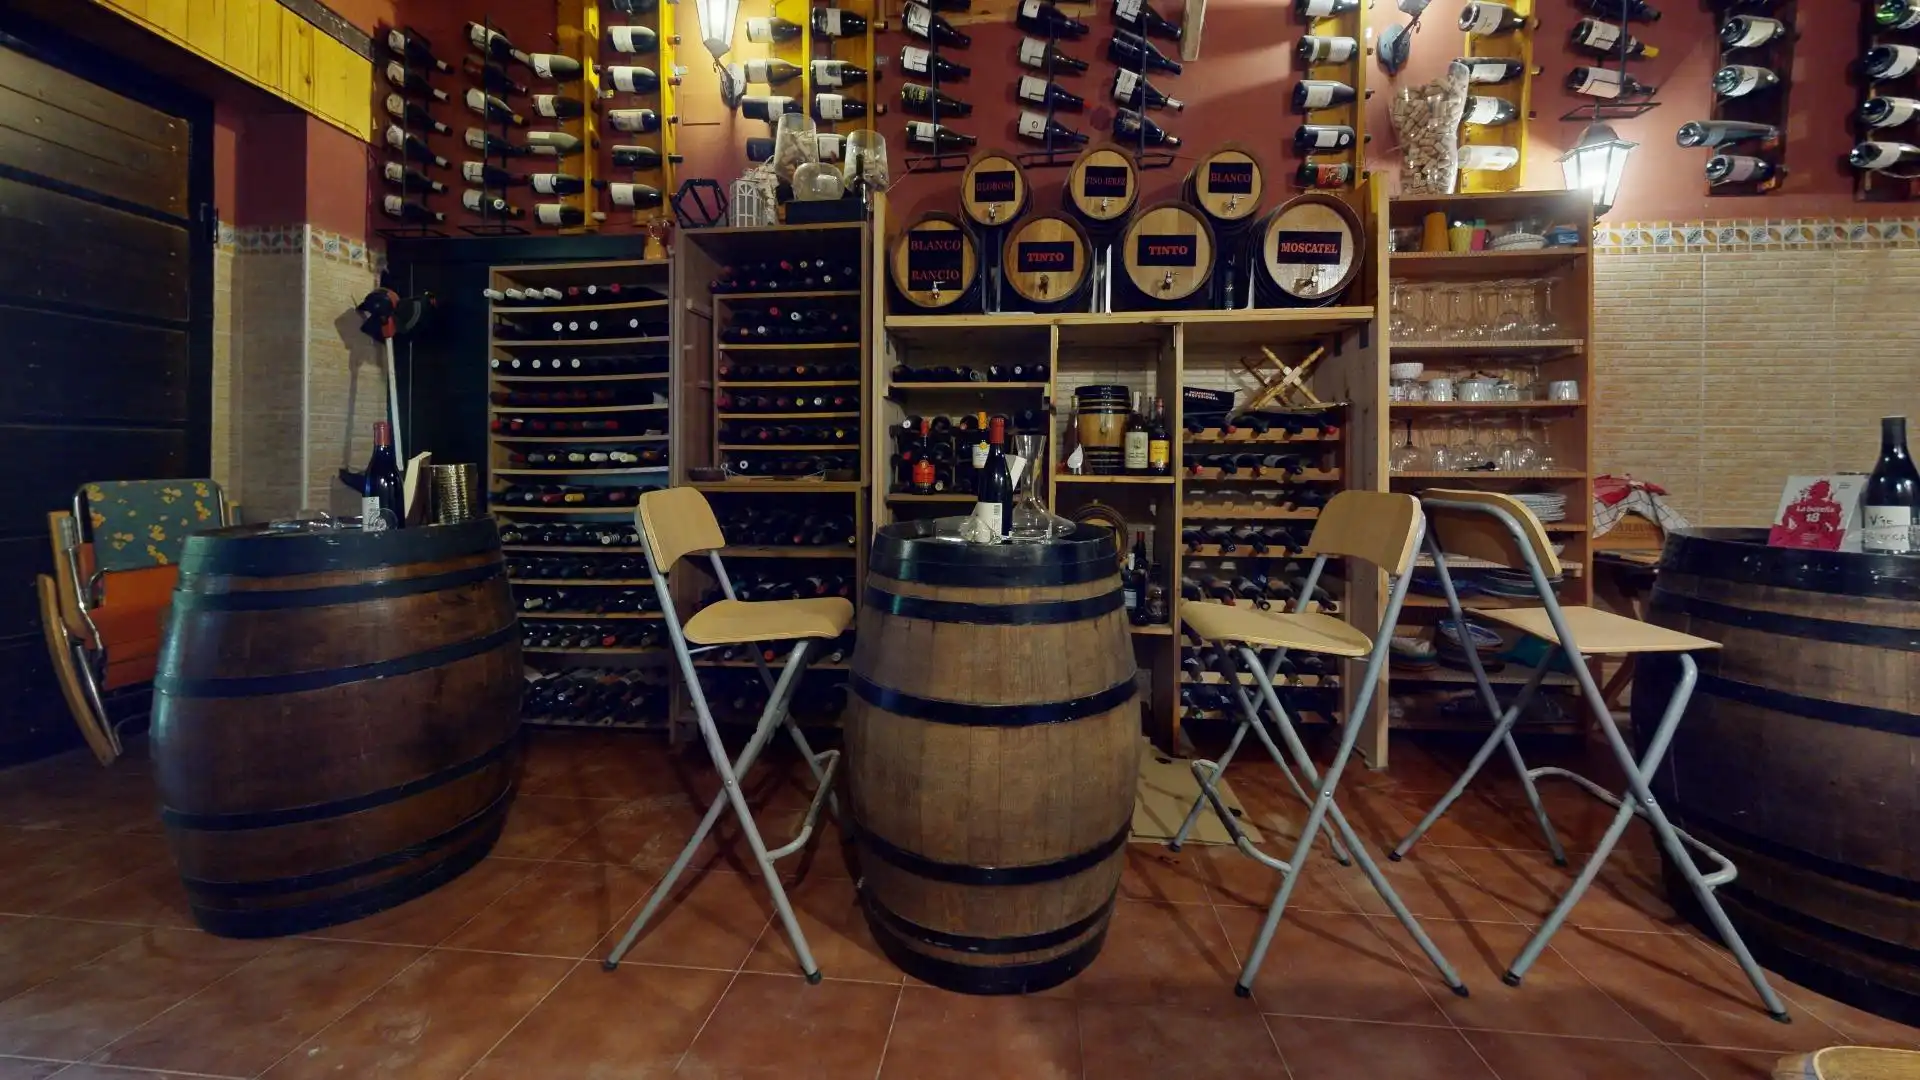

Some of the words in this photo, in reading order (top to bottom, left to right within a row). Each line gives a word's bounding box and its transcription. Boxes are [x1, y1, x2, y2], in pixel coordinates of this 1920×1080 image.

[1211, 172, 1251, 183] BLANCO
[910, 239, 960, 251] BLANCO
[1148, 245, 1188, 256] TINTO
[1280, 242, 1338, 254] MOSCATEL
[1026, 251, 1065, 262] TINTO
[911, 268, 960, 280] RANCIO
